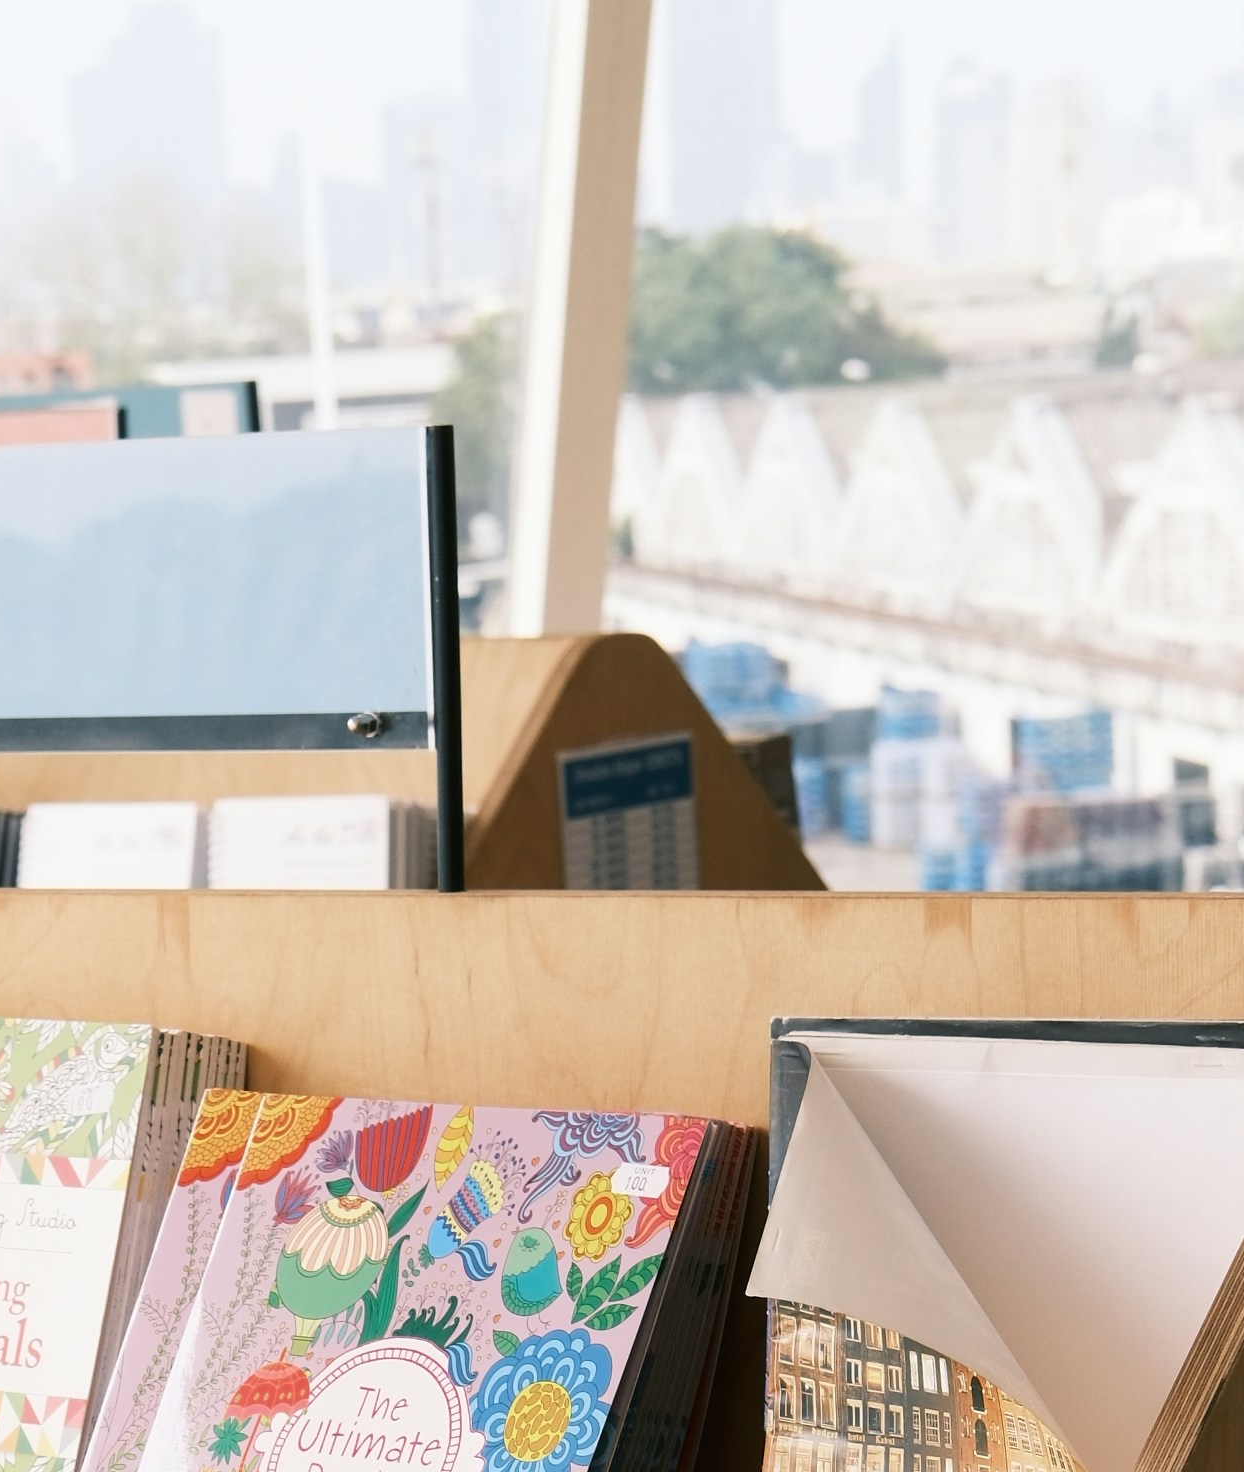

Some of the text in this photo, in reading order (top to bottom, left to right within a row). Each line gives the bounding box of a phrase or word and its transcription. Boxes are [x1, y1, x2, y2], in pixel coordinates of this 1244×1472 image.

[634, 1167, 657, 1175] UNIT
[16, 1198, 77, 1230] Studio
[357, 1386, 408, 1421] The
[298, 1418, 441, 1466] Ultimate
